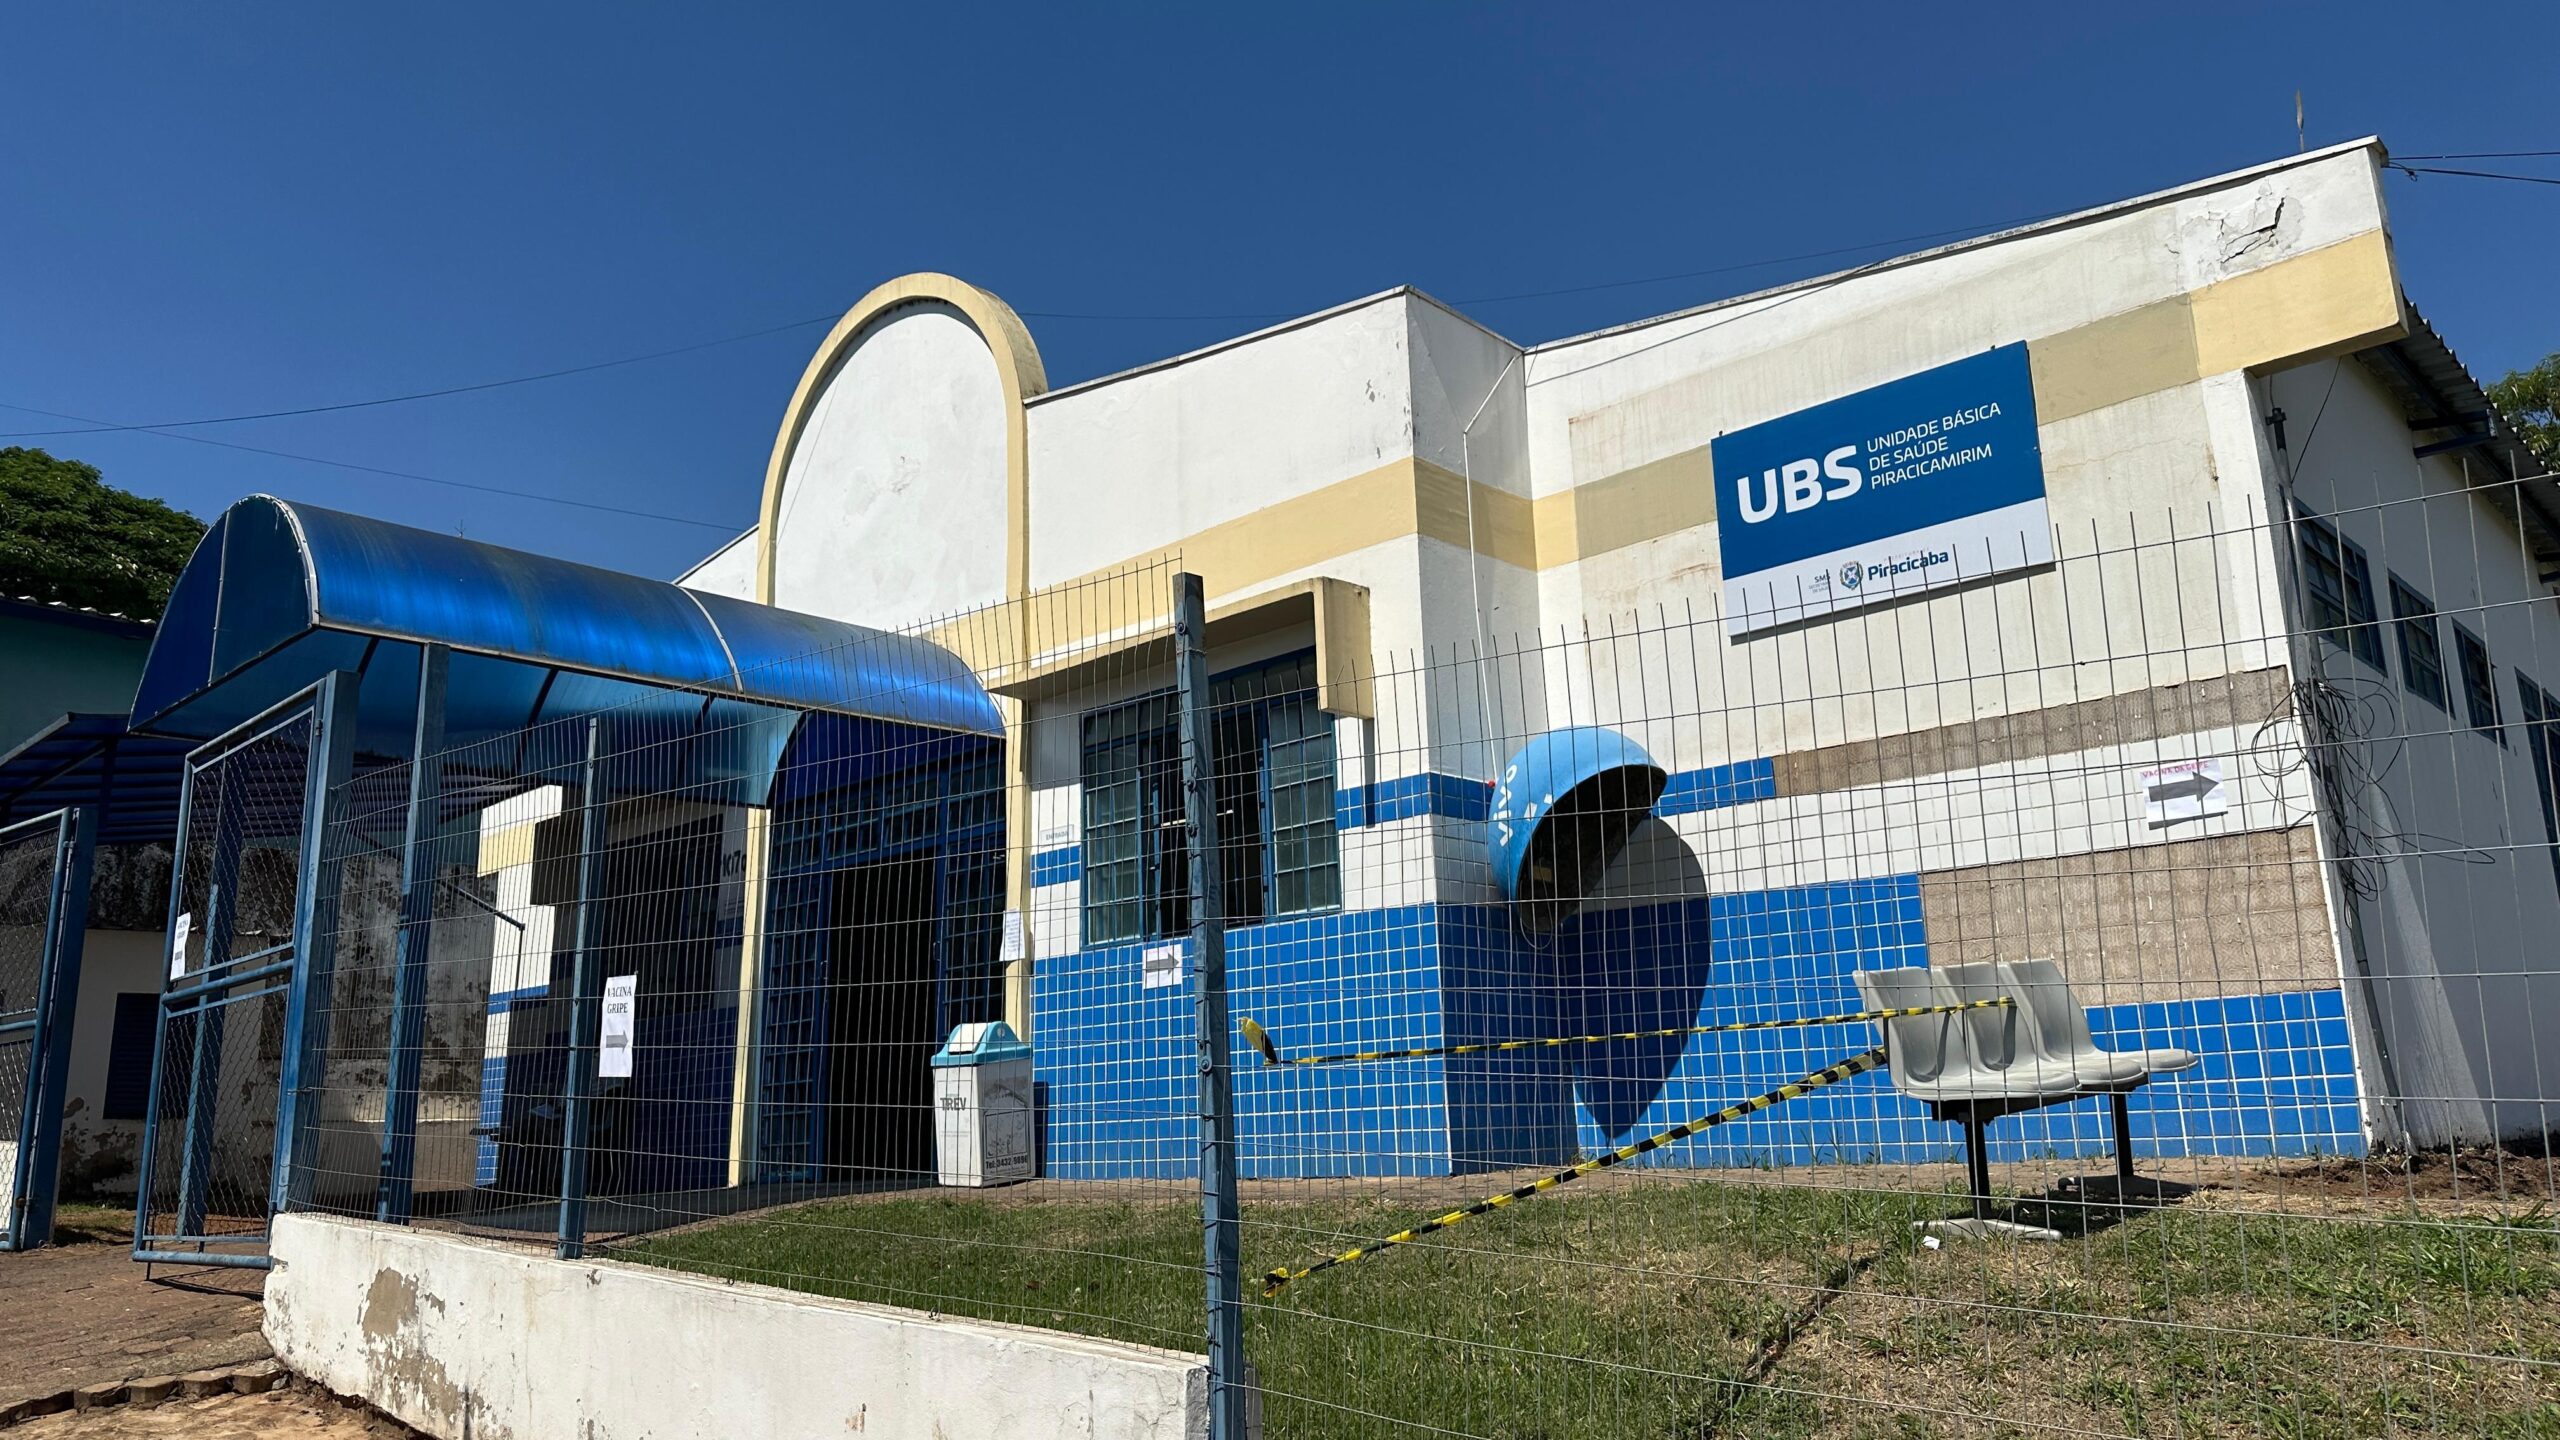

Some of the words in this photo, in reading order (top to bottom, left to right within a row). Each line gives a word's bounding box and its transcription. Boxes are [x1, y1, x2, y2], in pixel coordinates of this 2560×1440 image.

[1867, 421, 1939, 452] UNIDADE
[1942, 402, 2001, 432] BÁSICA
[1869, 454, 1890, 471] DE
[1893, 436, 1949, 465] SAÚDE
[1870, 443, 1993, 490] PIRACICAMIRIM
[1737, 445, 1863, 524] UBS
[1868, 551, 1949, 581] Piracicaba
[2143, 768, 2172, 778] VACNA
[2187, 761, 2208, 770] GRPE
[1494, 765, 1517, 846] vivo
[607, 1002, 628, 1013] GRIPE
[608, 986, 632, 997] VACINA
[940, 1097, 967, 1111] TREV
